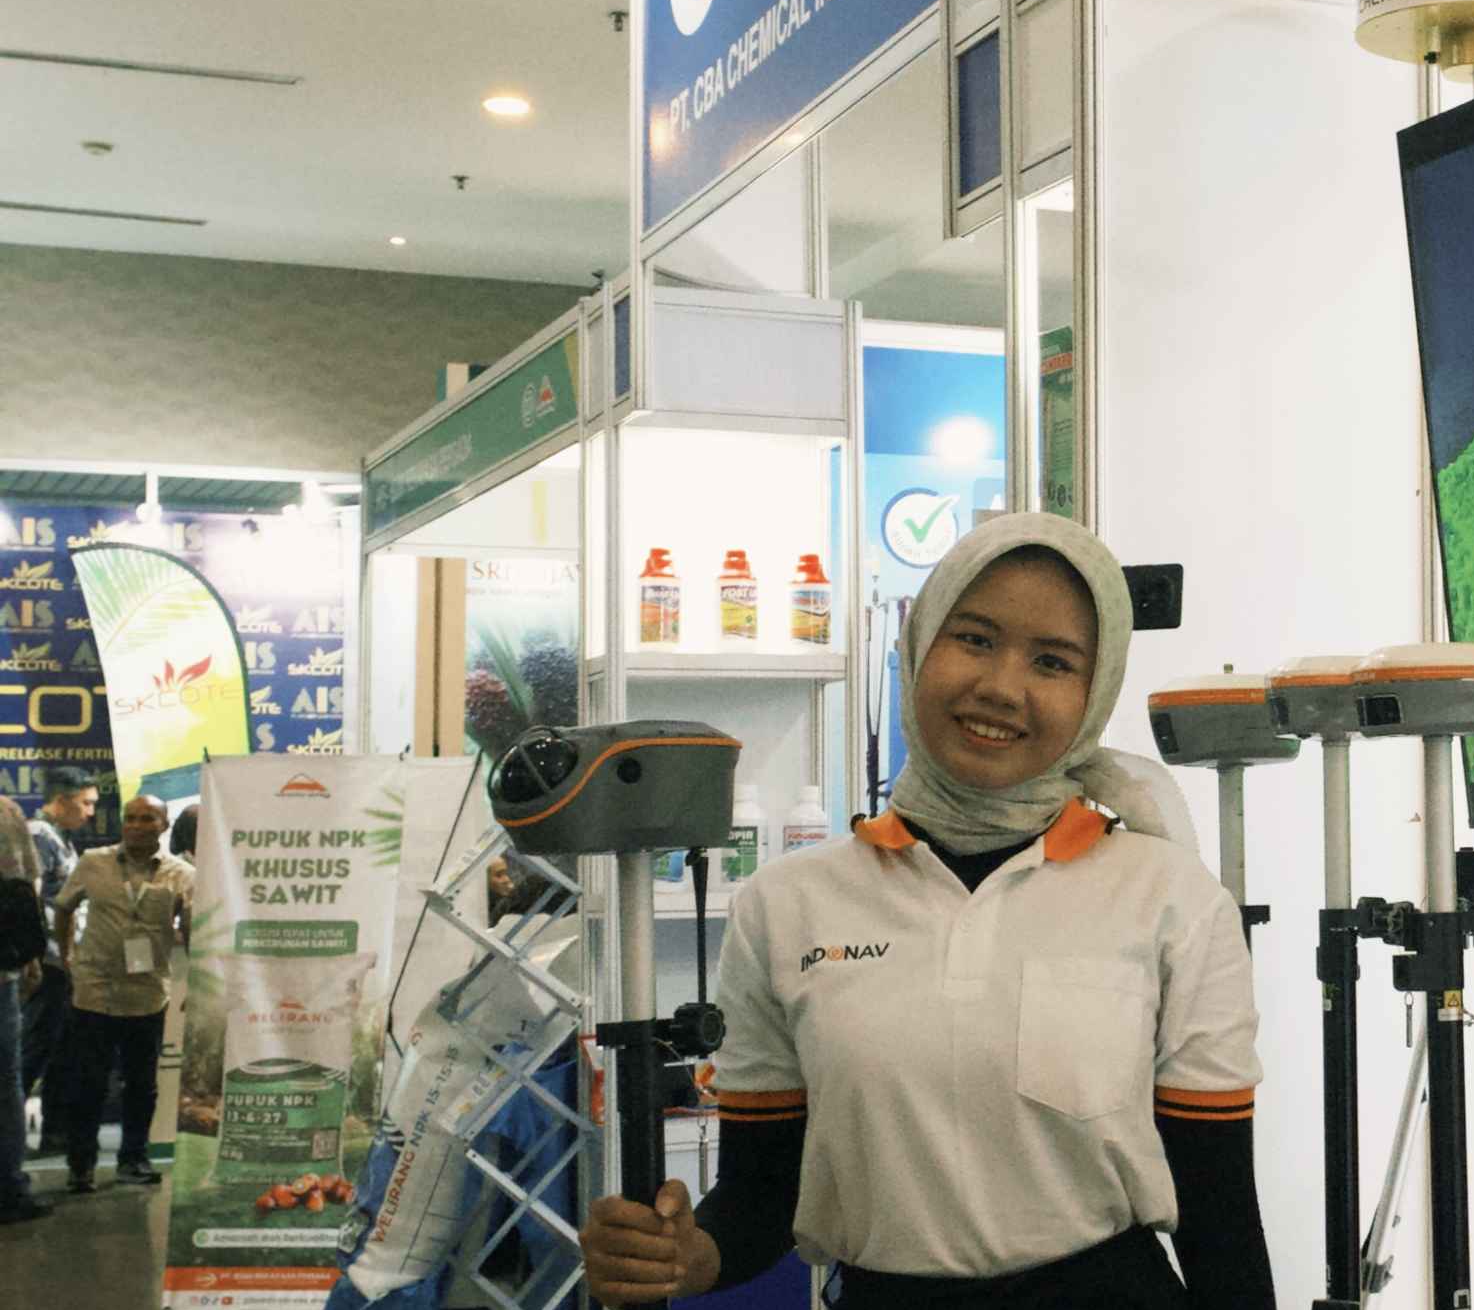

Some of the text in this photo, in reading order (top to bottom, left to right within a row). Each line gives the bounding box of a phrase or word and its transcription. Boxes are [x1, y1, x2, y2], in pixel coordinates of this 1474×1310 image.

[670, 89, 691, 132] PT.
[693, 59, 724, 120] CBA
[0, 600, 54, 627] AIS
[0, 748, 115, 761] RELEASE FERTIL
[231, 830, 366, 848] PUPUK NPK
[243, 859, 351, 878] KHUSUS
[250, 884, 343, 904] SAWIT
[801, 942, 890, 973] INDONAV
[226, 1094, 315, 1106] PUPUK NPK
[374, 1149, 416, 1242] WELIRANG
[410, 1110, 431, 1147] NPK
